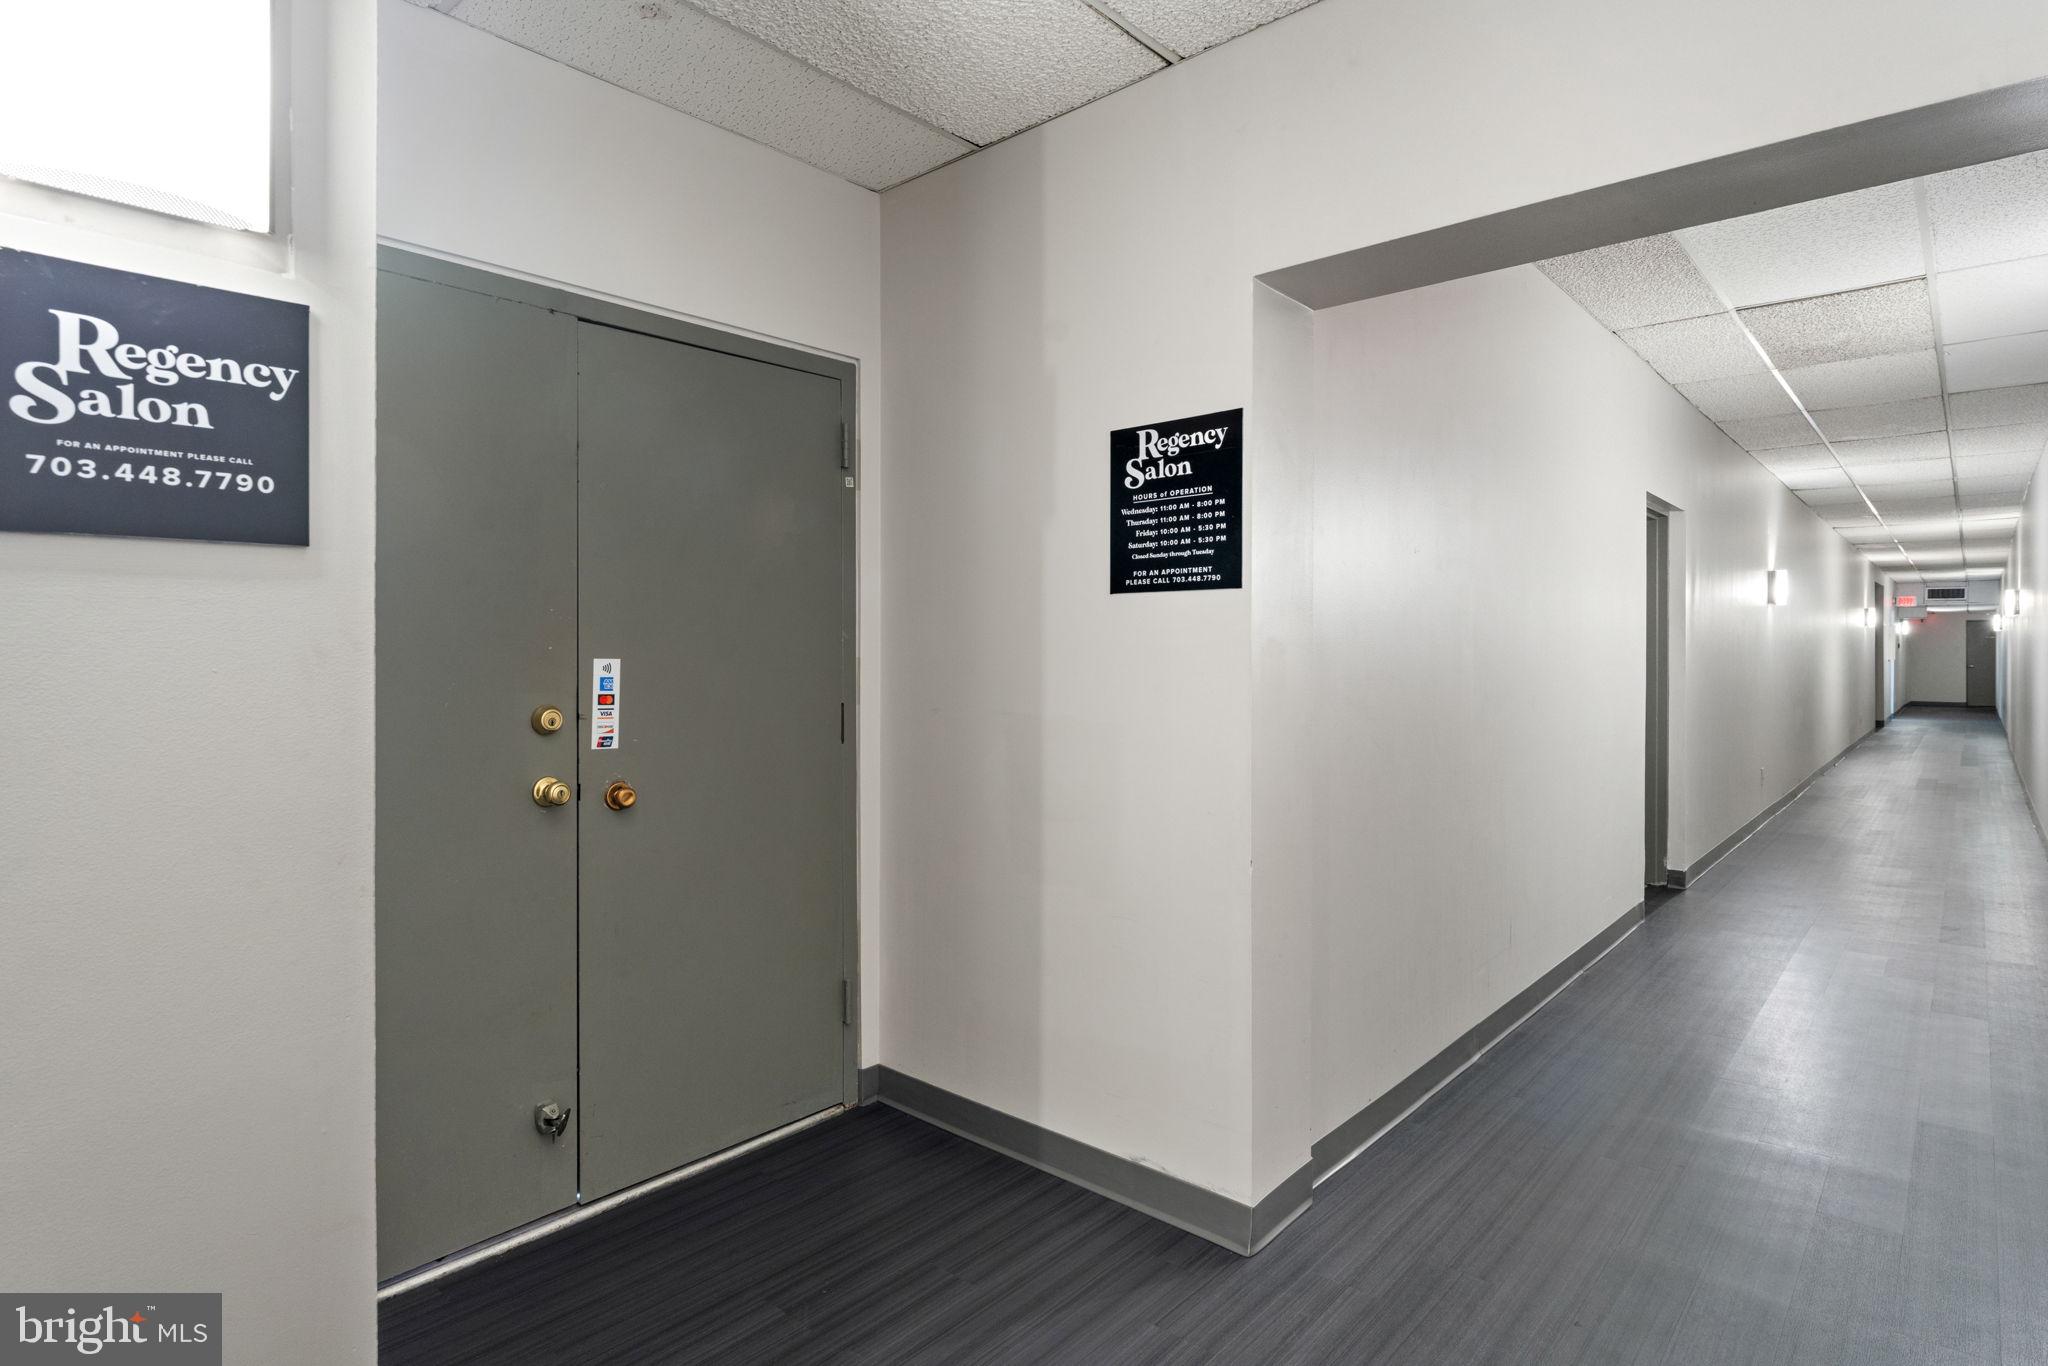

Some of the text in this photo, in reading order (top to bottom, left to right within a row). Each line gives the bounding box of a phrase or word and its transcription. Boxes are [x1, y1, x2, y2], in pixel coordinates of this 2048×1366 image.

[48, 309, 299, 401] Regency
[9, 361, 214, 429] Salon
[56, 439, 254, 466] FOR AN APPOINTMENT PLEASE CALL
[1136, 427, 1228, 456] Regency
[25, 454, 275, 494] 703.448.7790
[1124, 458, 1193, 489] Salon
[1133, 493, 1157, 501] HOURS
[1170, 486, 1213, 496] OPERATION
[1121, 505, 1158, 515] Wednesday:
[1126, 518, 1158, 527] Thursday:
[1126, 578, 1150, 586] PLEASE
[1173, 575, 1221, 583] 703.448.7790
[1161, 566, 1212, 575] APPOINTMENT
